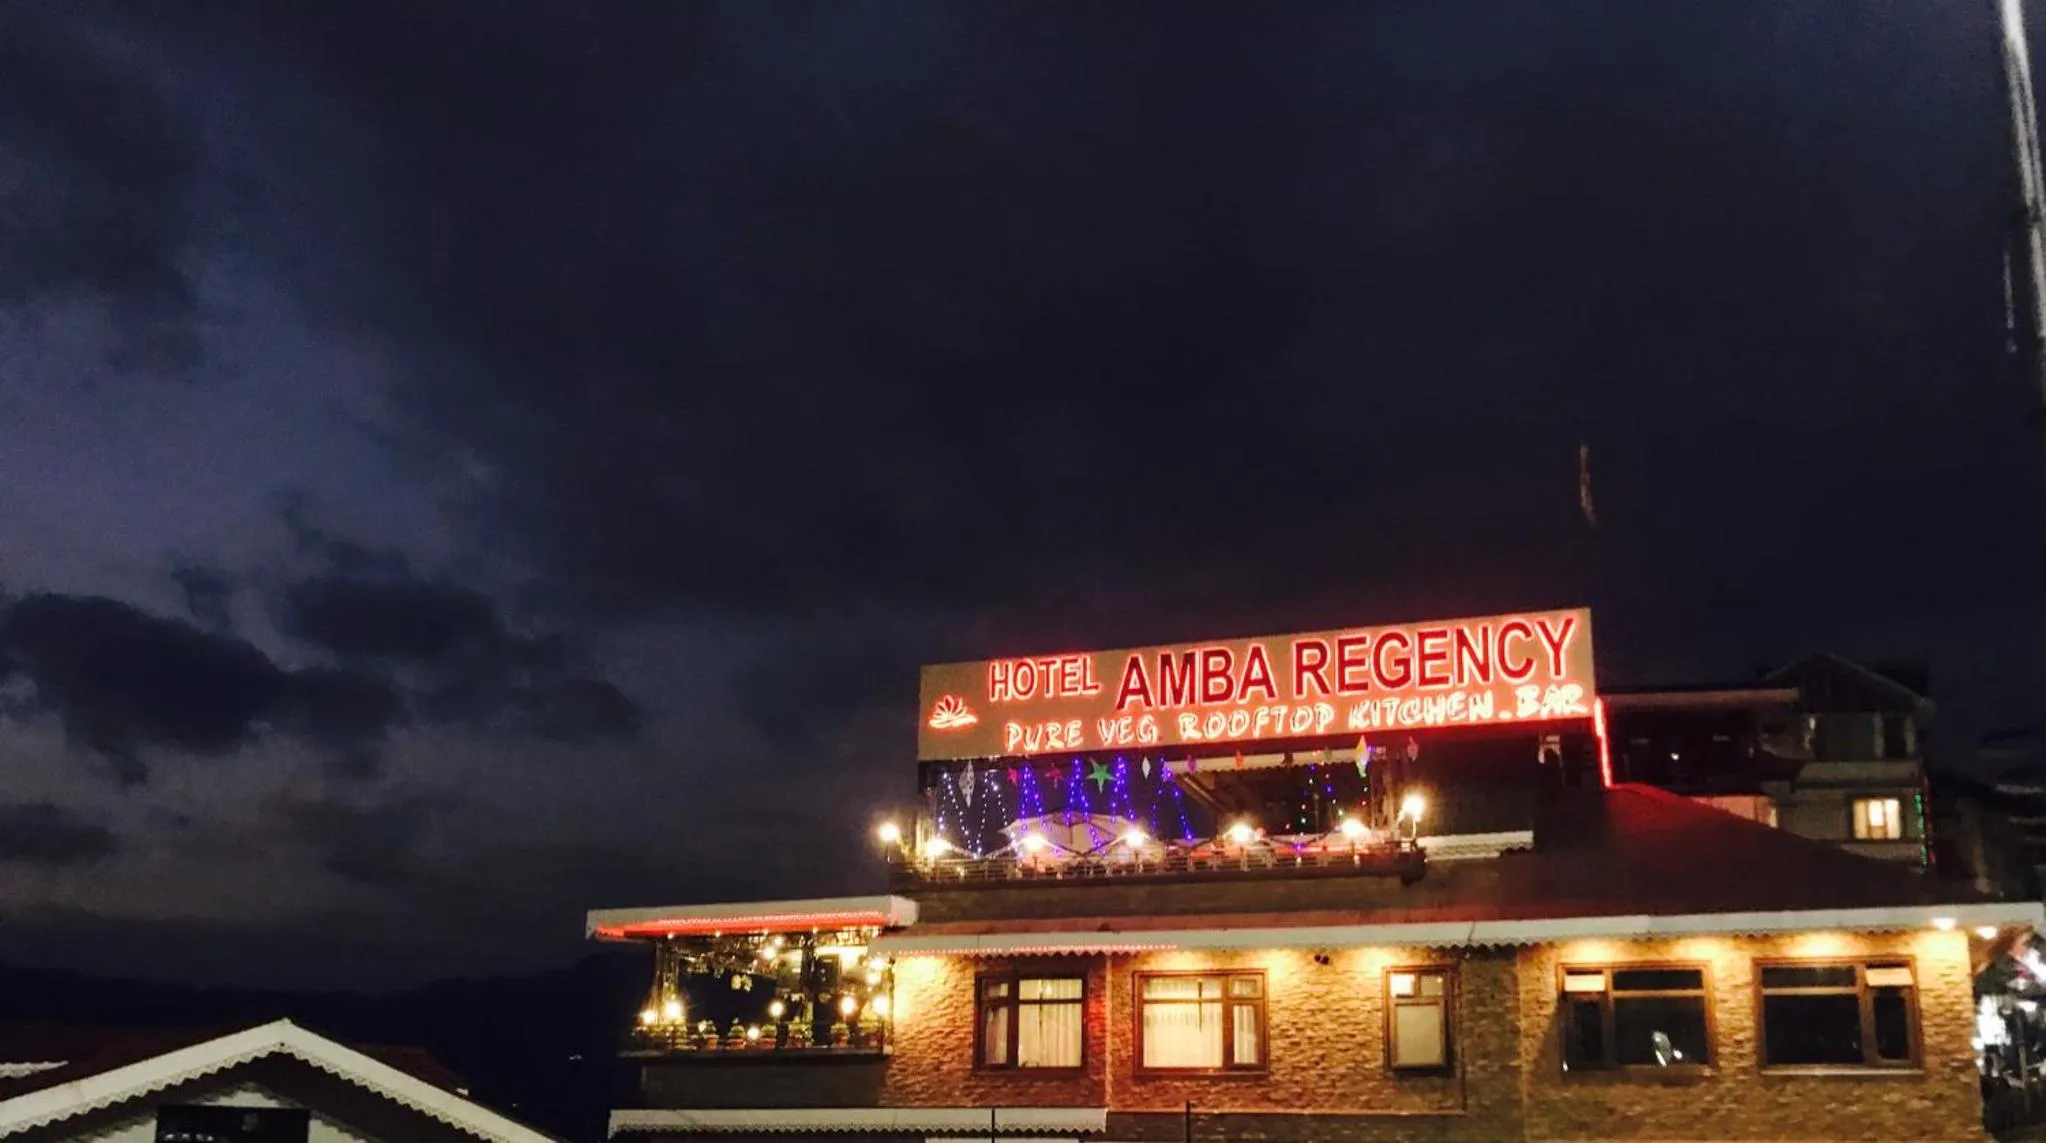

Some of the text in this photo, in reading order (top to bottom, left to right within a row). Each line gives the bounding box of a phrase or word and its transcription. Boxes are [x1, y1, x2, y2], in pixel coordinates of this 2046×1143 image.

[989, 616, 1577, 710] HOTEL AMBA REGENCY
[1005, 720, 1085, 752] PURE
[1097, 715, 1159, 746] VEG
[1178, 702, 1335, 740] ROOFTOP
